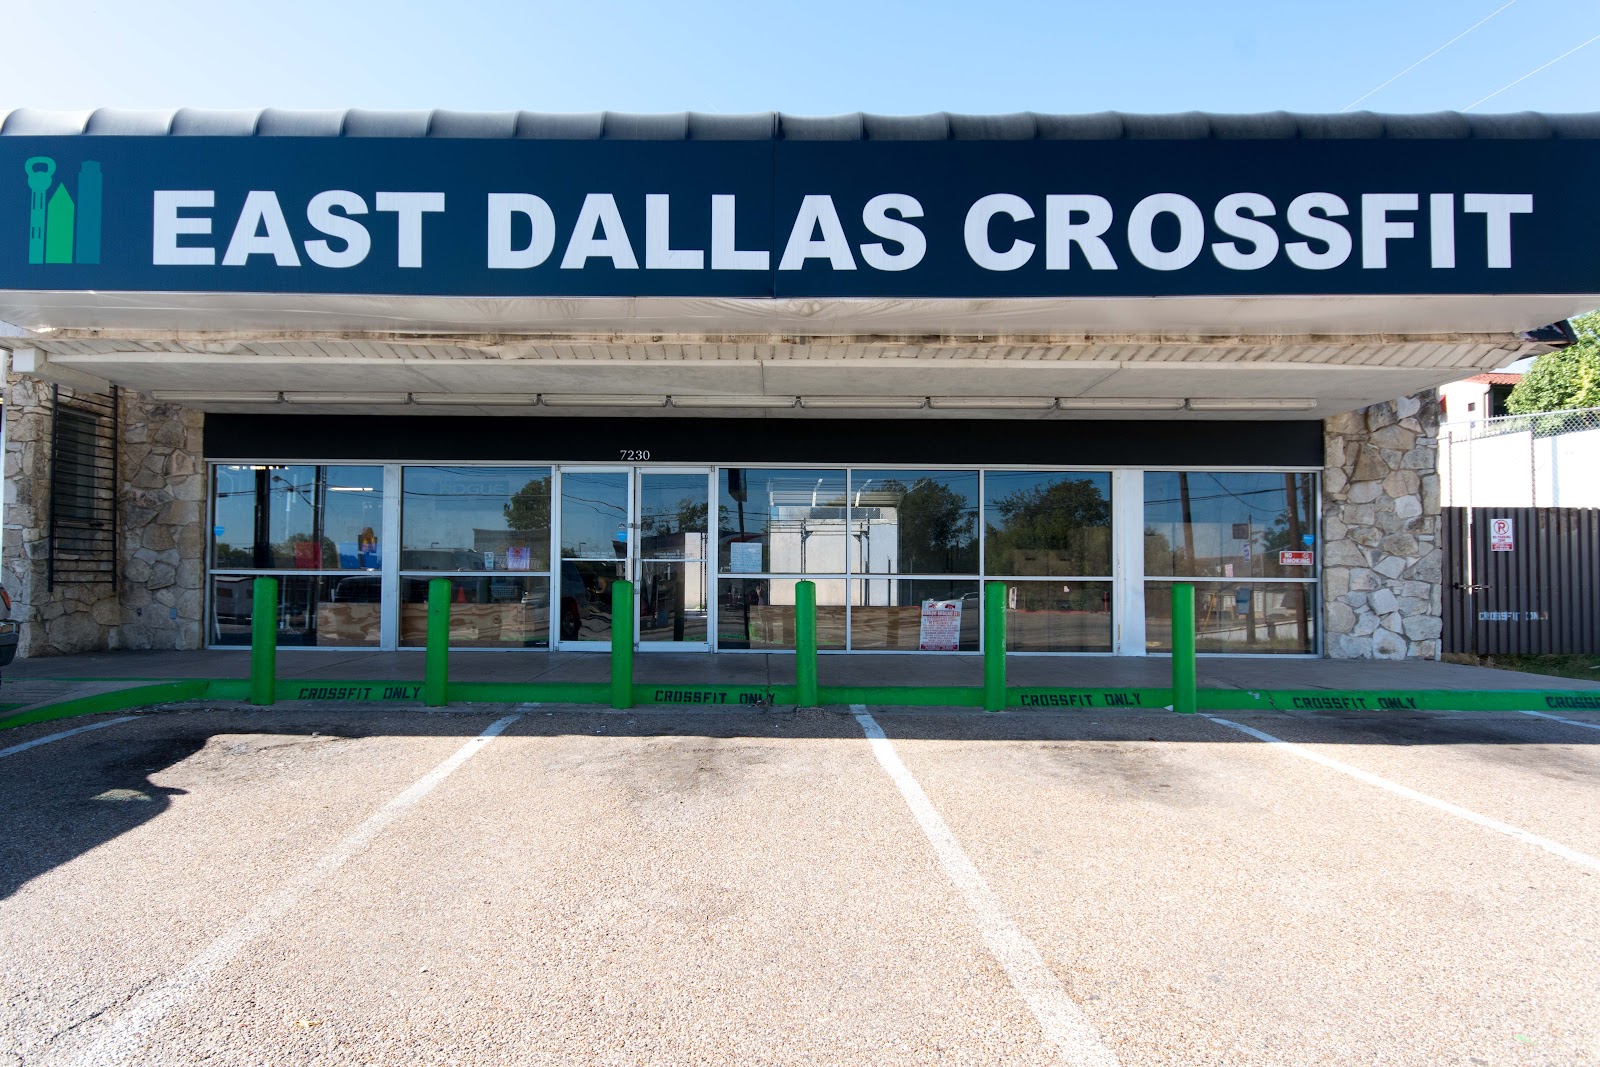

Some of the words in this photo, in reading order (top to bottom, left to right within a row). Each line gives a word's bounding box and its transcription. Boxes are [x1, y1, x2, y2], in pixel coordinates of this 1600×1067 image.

[153, 190, 446, 268] EAST
[488, 193, 927, 271] DALLAS
[964, 193, 1534, 271] CROSSFIT
[620, 450, 650, 461] 7230
[298, 687, 373, 699] CROSSFIT
[383, 686, 421, 699] ONLY
[654, 690, 727, 704] CROSSFIT
[1021, 694, 1092, 706] CROSSFIT
[1104, 693, 1141, 706] ONLY
[1292, 698, 1367, 709] CROSSFIT
[1378, 698, 1417, 709] ONLY
